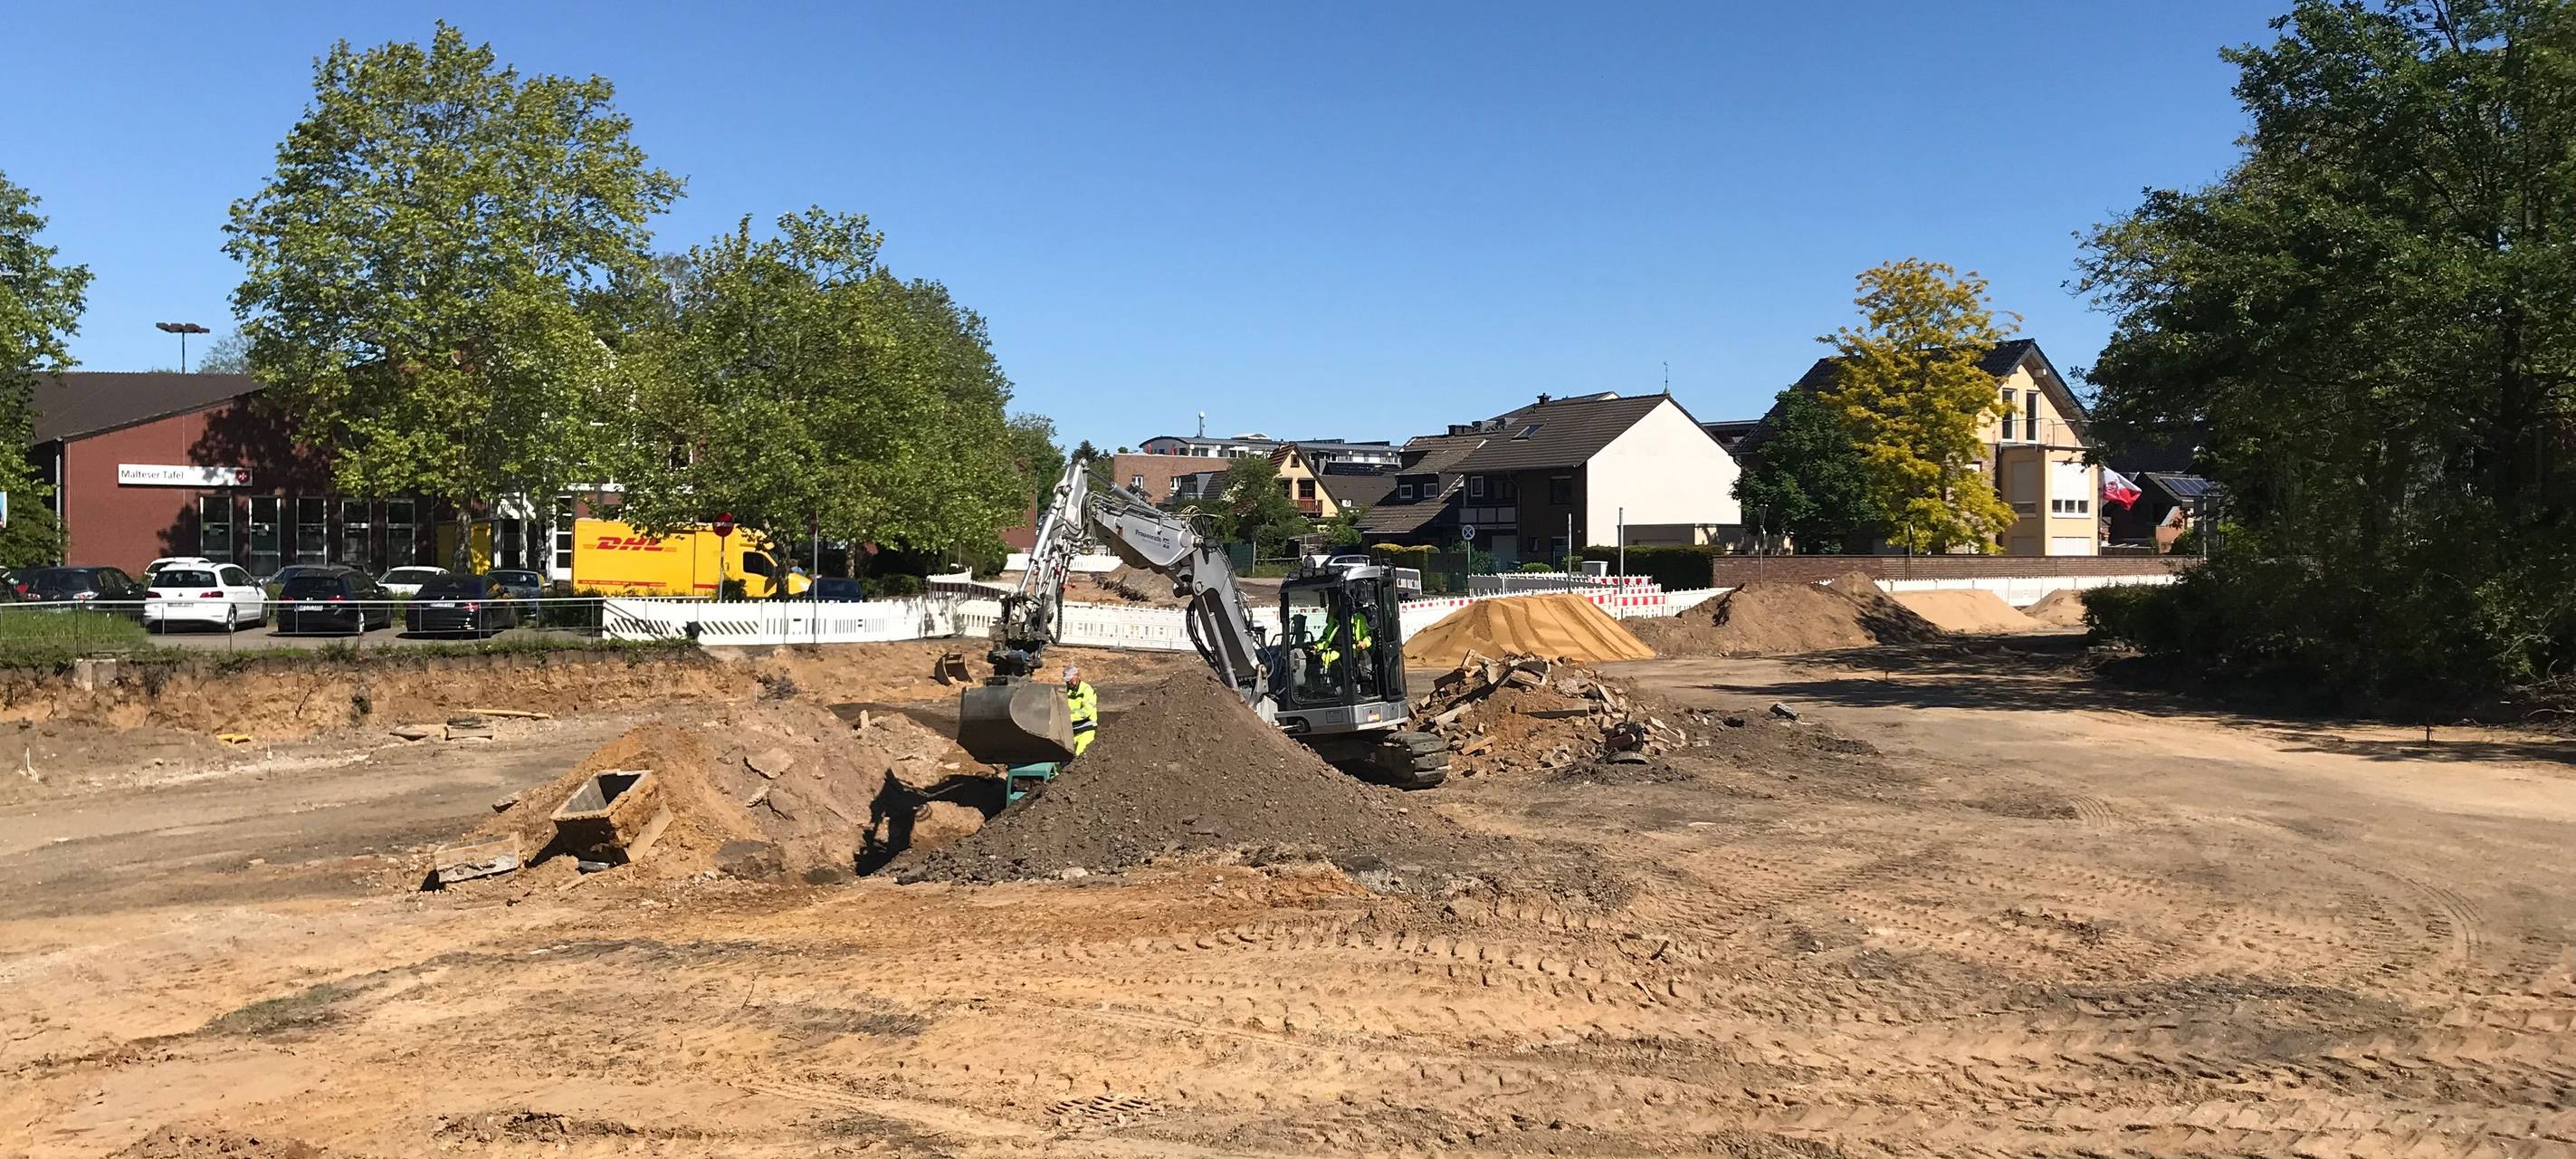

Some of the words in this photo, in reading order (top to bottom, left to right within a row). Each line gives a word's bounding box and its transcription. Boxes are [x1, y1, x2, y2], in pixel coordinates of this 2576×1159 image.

[121, 470, 159, 478] Malteser
[163, 471, 184, 479] Tafel
[596, 536, 663, 551] DHL
